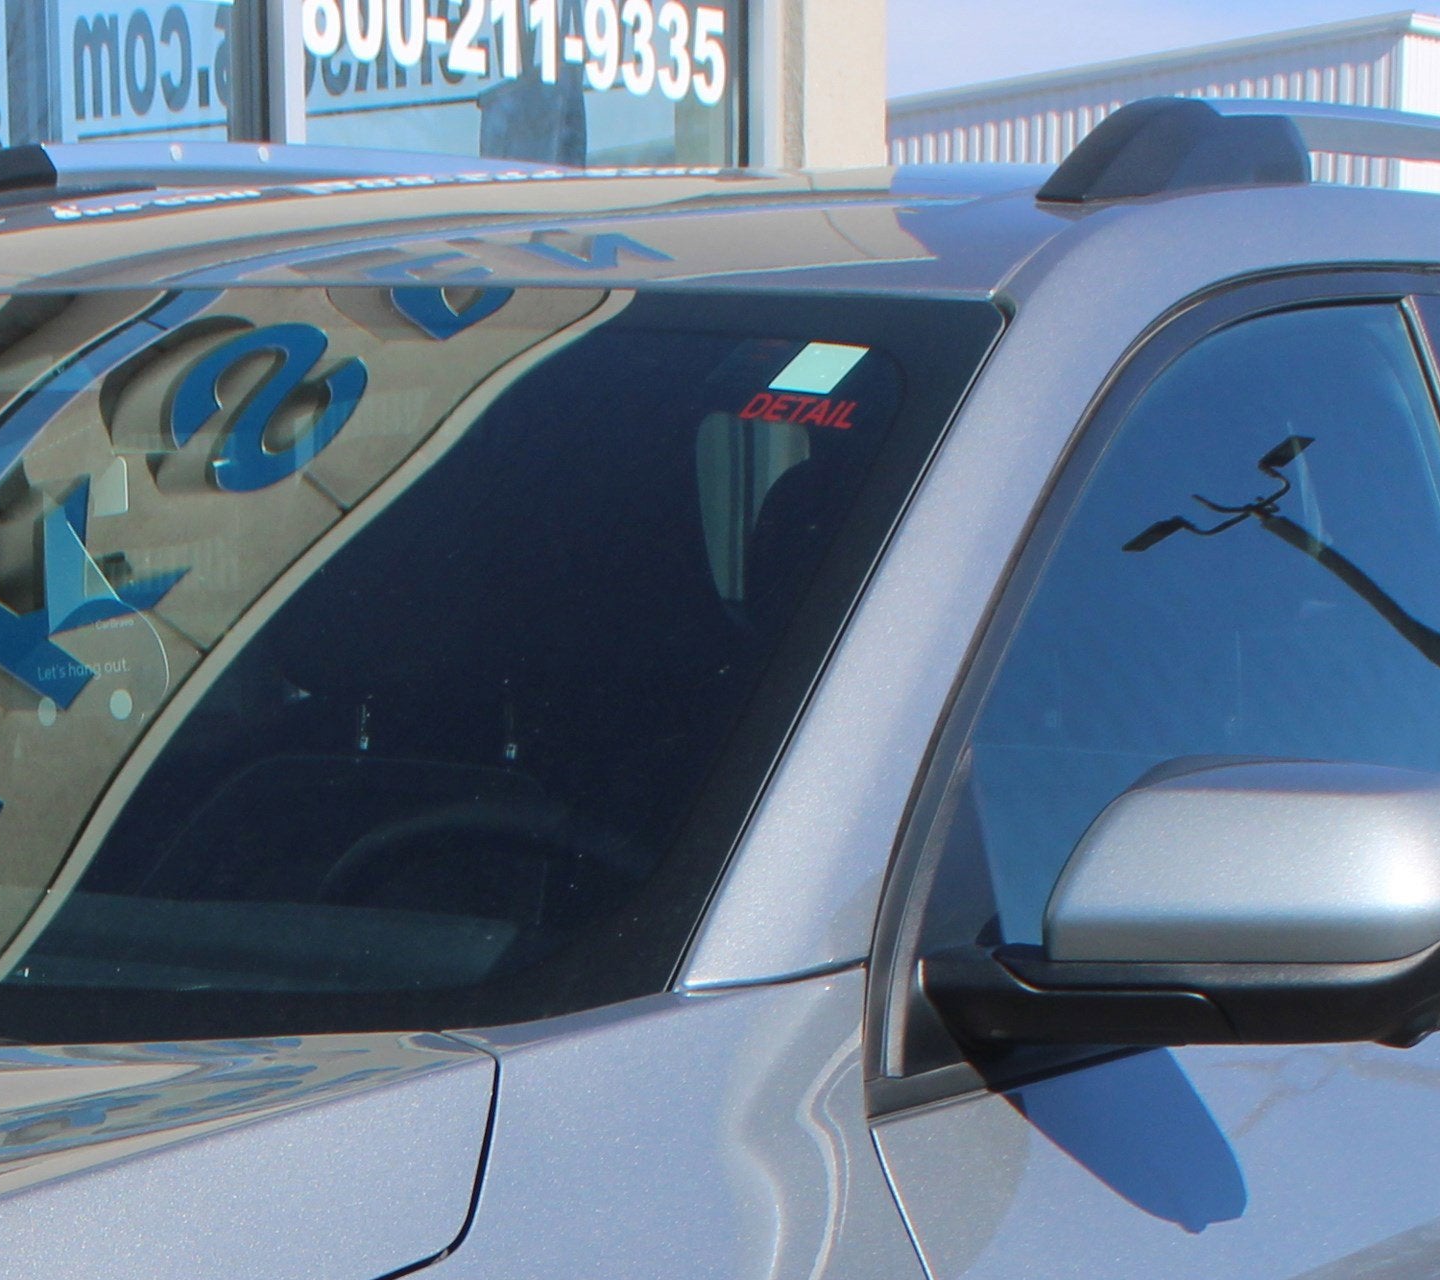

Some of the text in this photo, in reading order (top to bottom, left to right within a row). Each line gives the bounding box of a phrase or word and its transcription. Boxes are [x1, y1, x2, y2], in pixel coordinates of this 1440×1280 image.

[302, 0, 726, 106] 800-211-9335
[738, 392, 858, 430] DETAIL
[37, 663, 67, 682] Let's
[68, 659, 102, 681] hang
